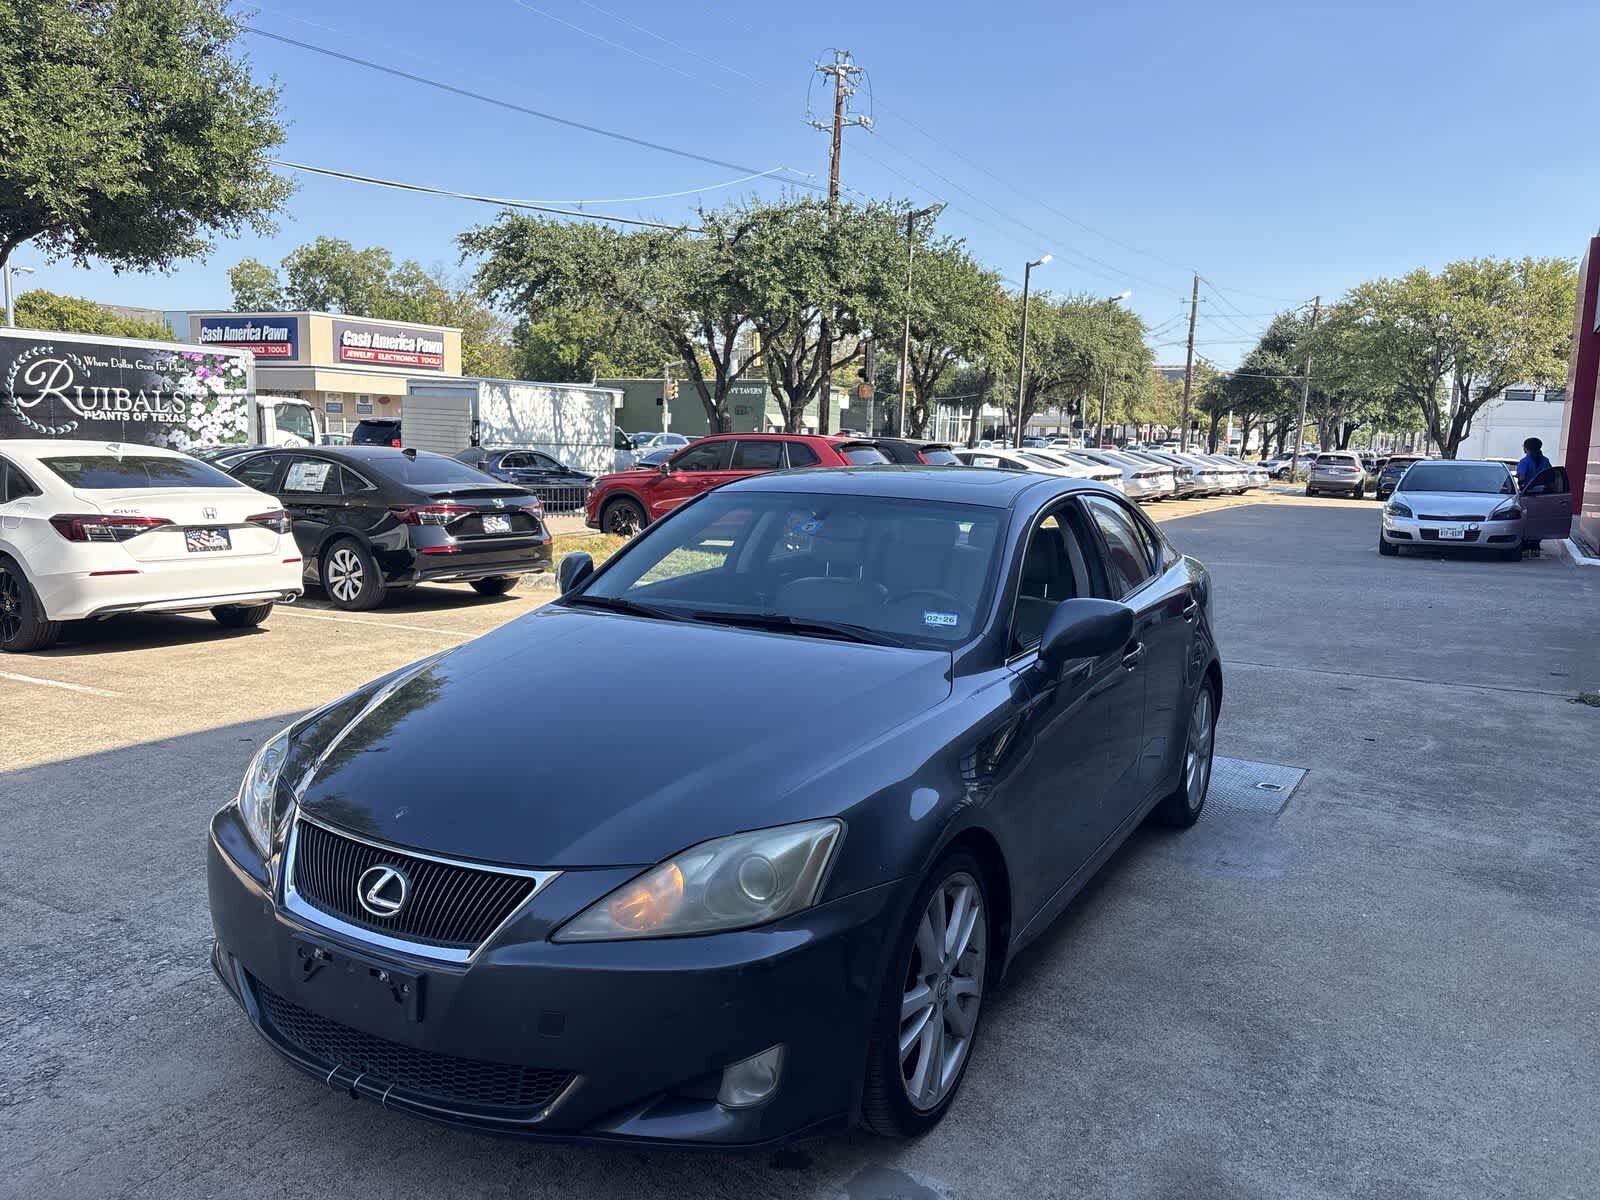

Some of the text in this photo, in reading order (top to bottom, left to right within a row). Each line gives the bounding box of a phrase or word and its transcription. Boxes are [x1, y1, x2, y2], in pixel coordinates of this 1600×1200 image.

[201, 325, 288, 341] Cash America Pawn
[343, 330, 443, 354] Cash America Pawn
[83, 355, 190, 373] Where Dallas Goes For Plants
[346, 350, 375, 360] JEWELRY
[377, 353, 418, 363] ELECTRONICS
[84, 410, 187, 423] PLANTS OF TEXAS
